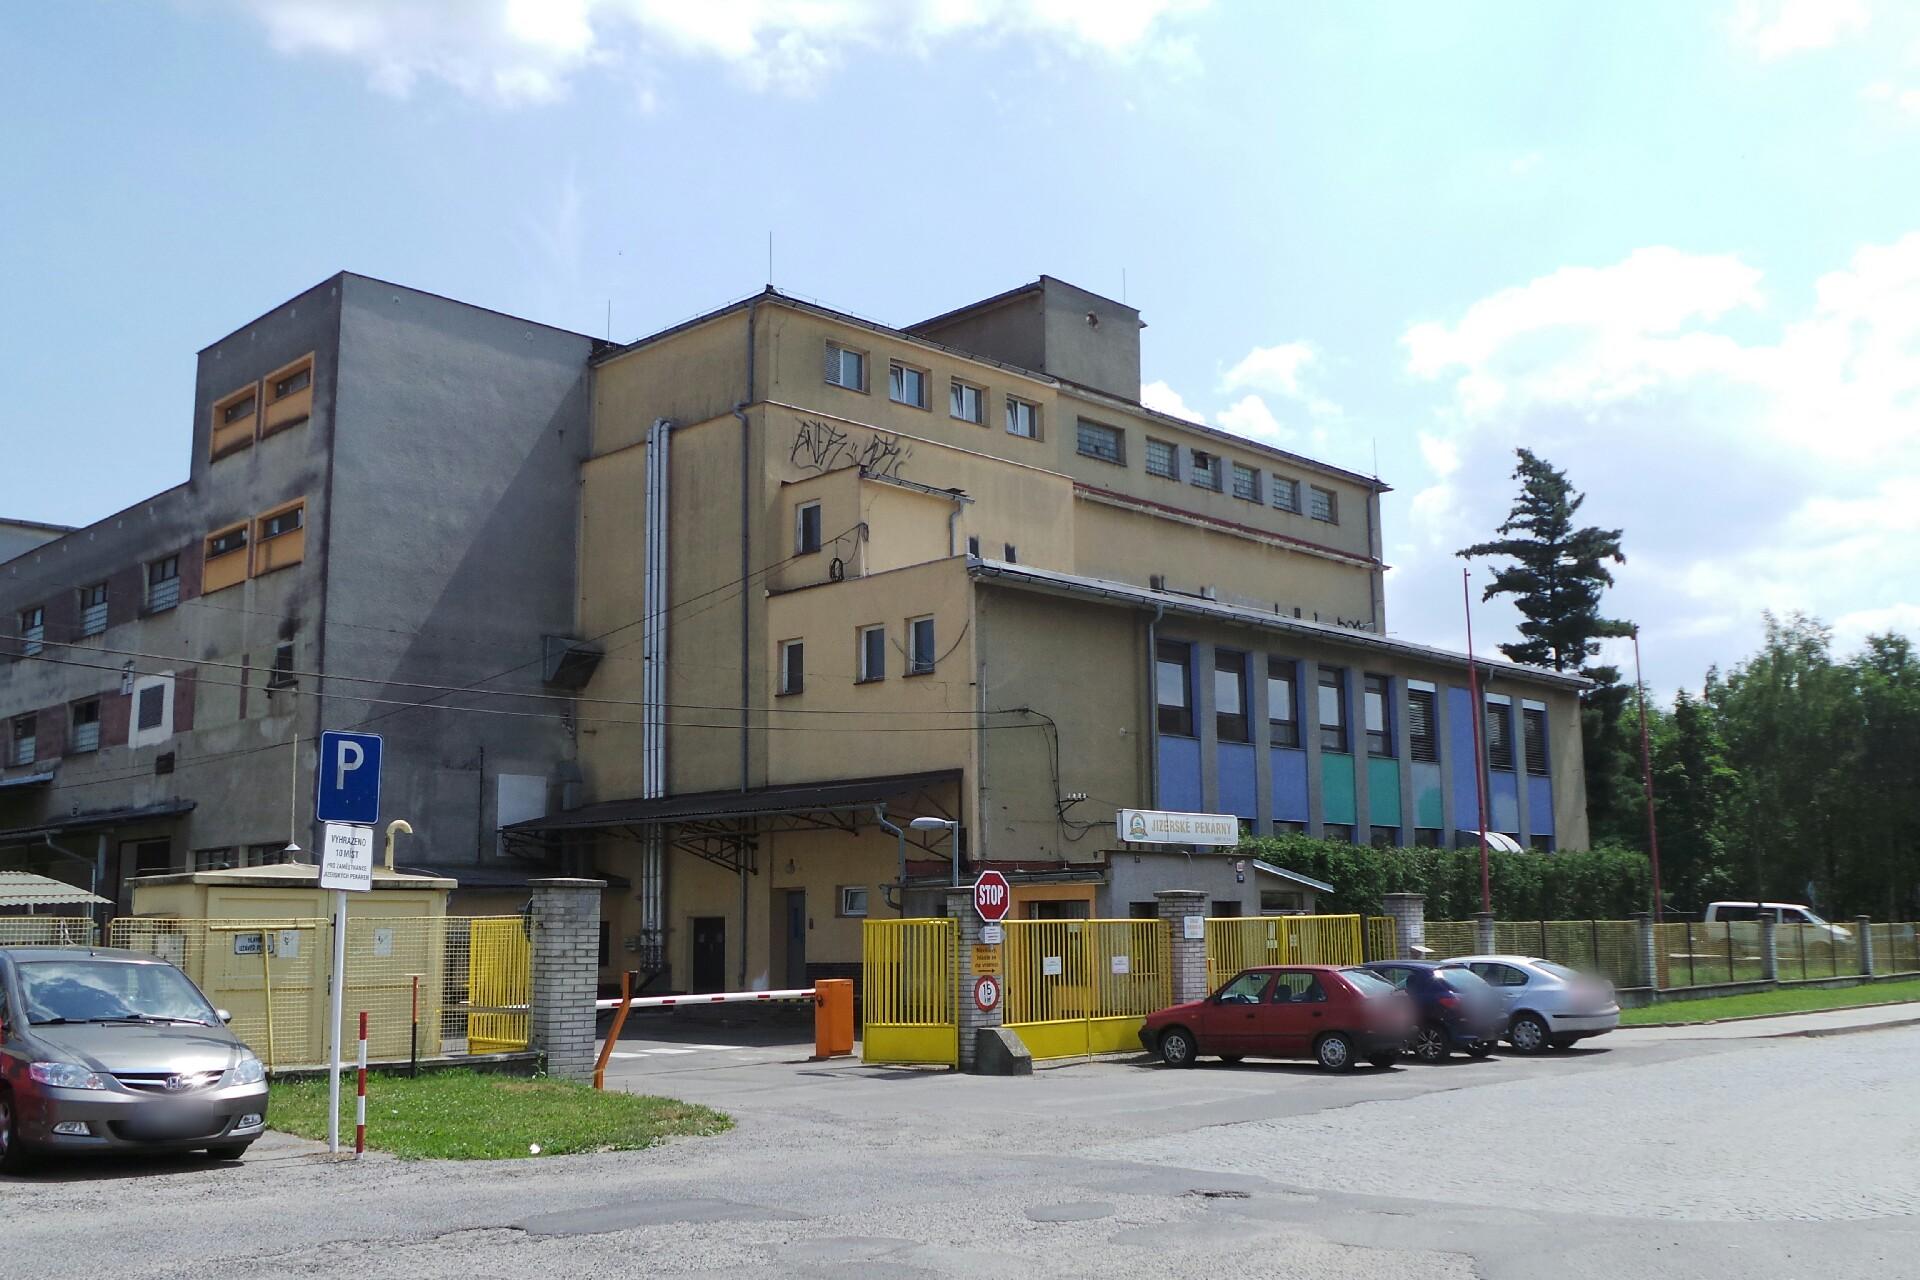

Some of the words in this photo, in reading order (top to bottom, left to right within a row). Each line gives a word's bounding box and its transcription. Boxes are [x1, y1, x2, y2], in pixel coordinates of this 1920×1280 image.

[336, 740, 364, 790] P
[1152, 818, 1190, 833] JIZERSKÉ
[1195, 820, 1232, 835] PEKÁRNY
[331, 834, 366, 847] VYHRAZENO
[336, 849, 343, 857] 10
[979, 884, 1004, 906] STOP
[982, 983, 992, 996] 15
